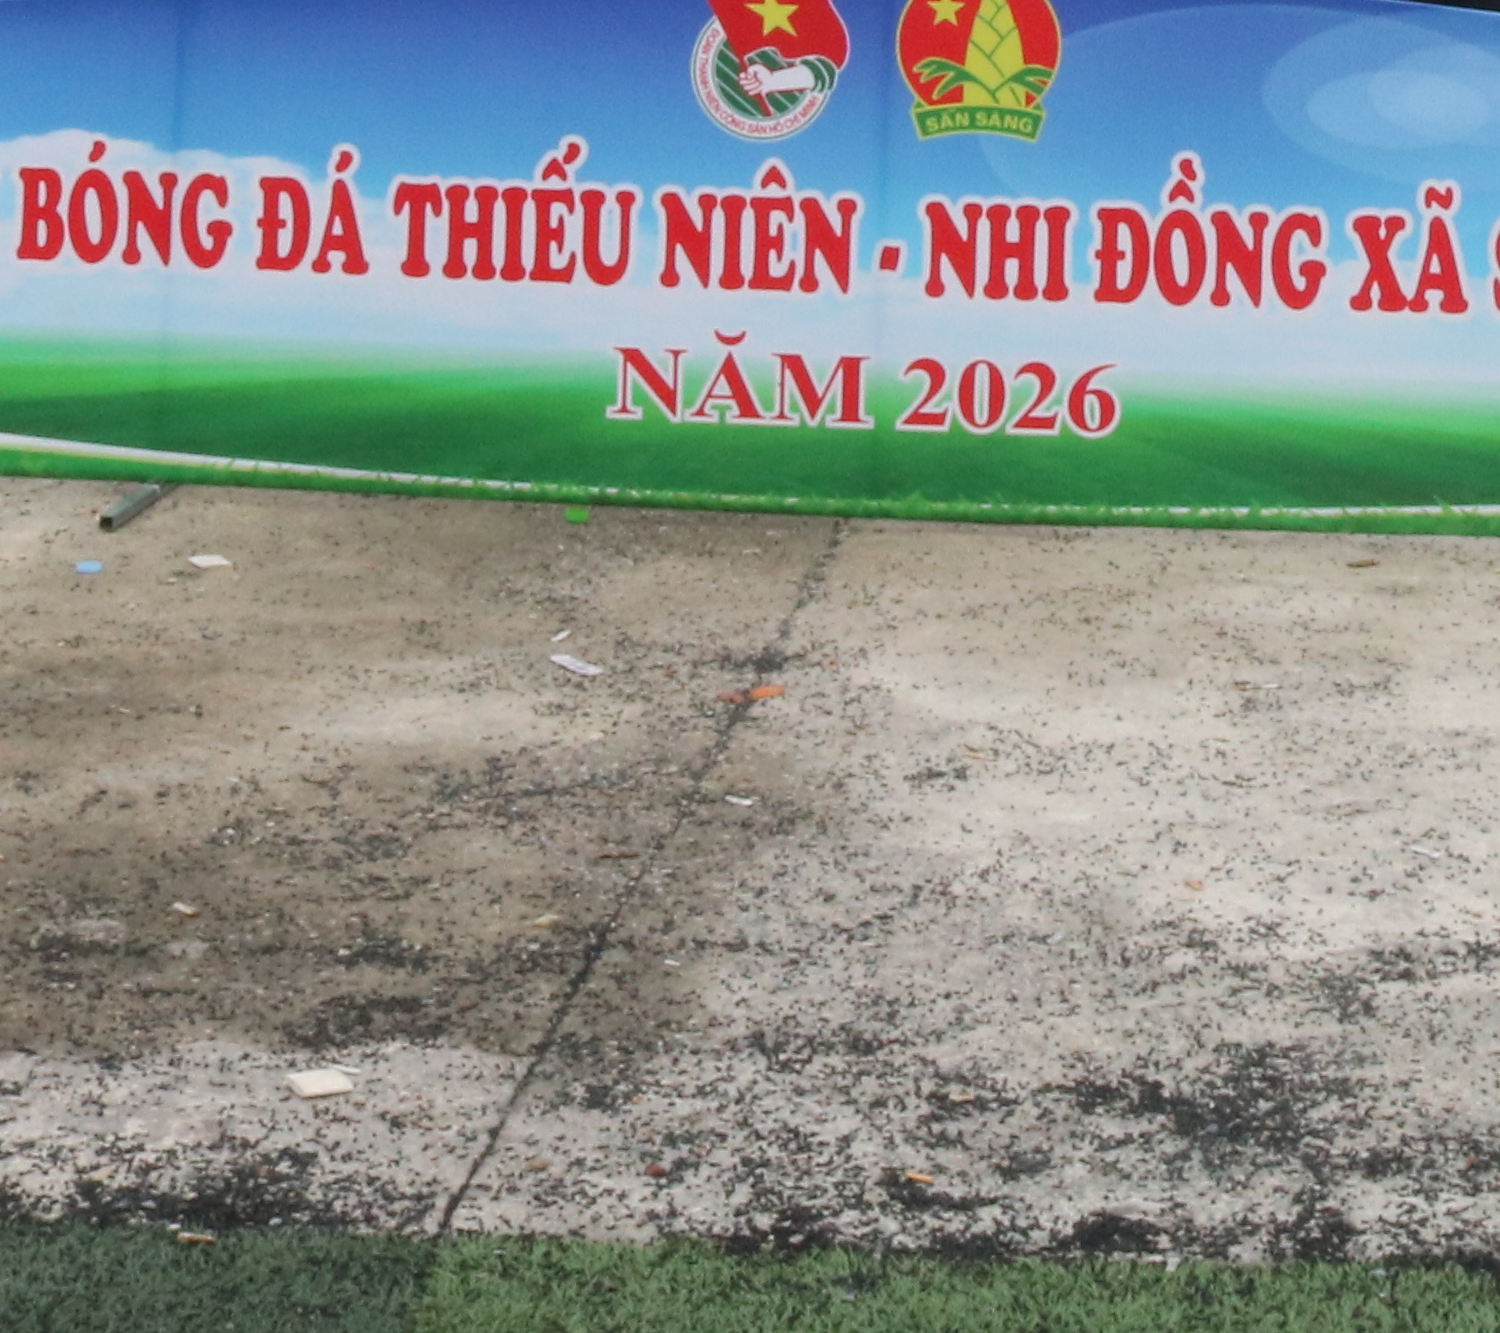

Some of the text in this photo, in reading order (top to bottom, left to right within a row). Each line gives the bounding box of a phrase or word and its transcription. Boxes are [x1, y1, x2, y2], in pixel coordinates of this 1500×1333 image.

[17, 140, 234, 269] BÓNG
[256, 150, 370, 275] ĐÁ
[393, 142, 636, 286] THIẾU
[659, 165, 857, 295] NIÊN
[879, 246, 901, 271] -
[924, 201, 1070, 302] NHI
[1094, 158, 1327, 310] ĐỒNG
[1350, 186, 1469, 313] XÃ
[611, 329, 1118, 433] NĂM 2026
